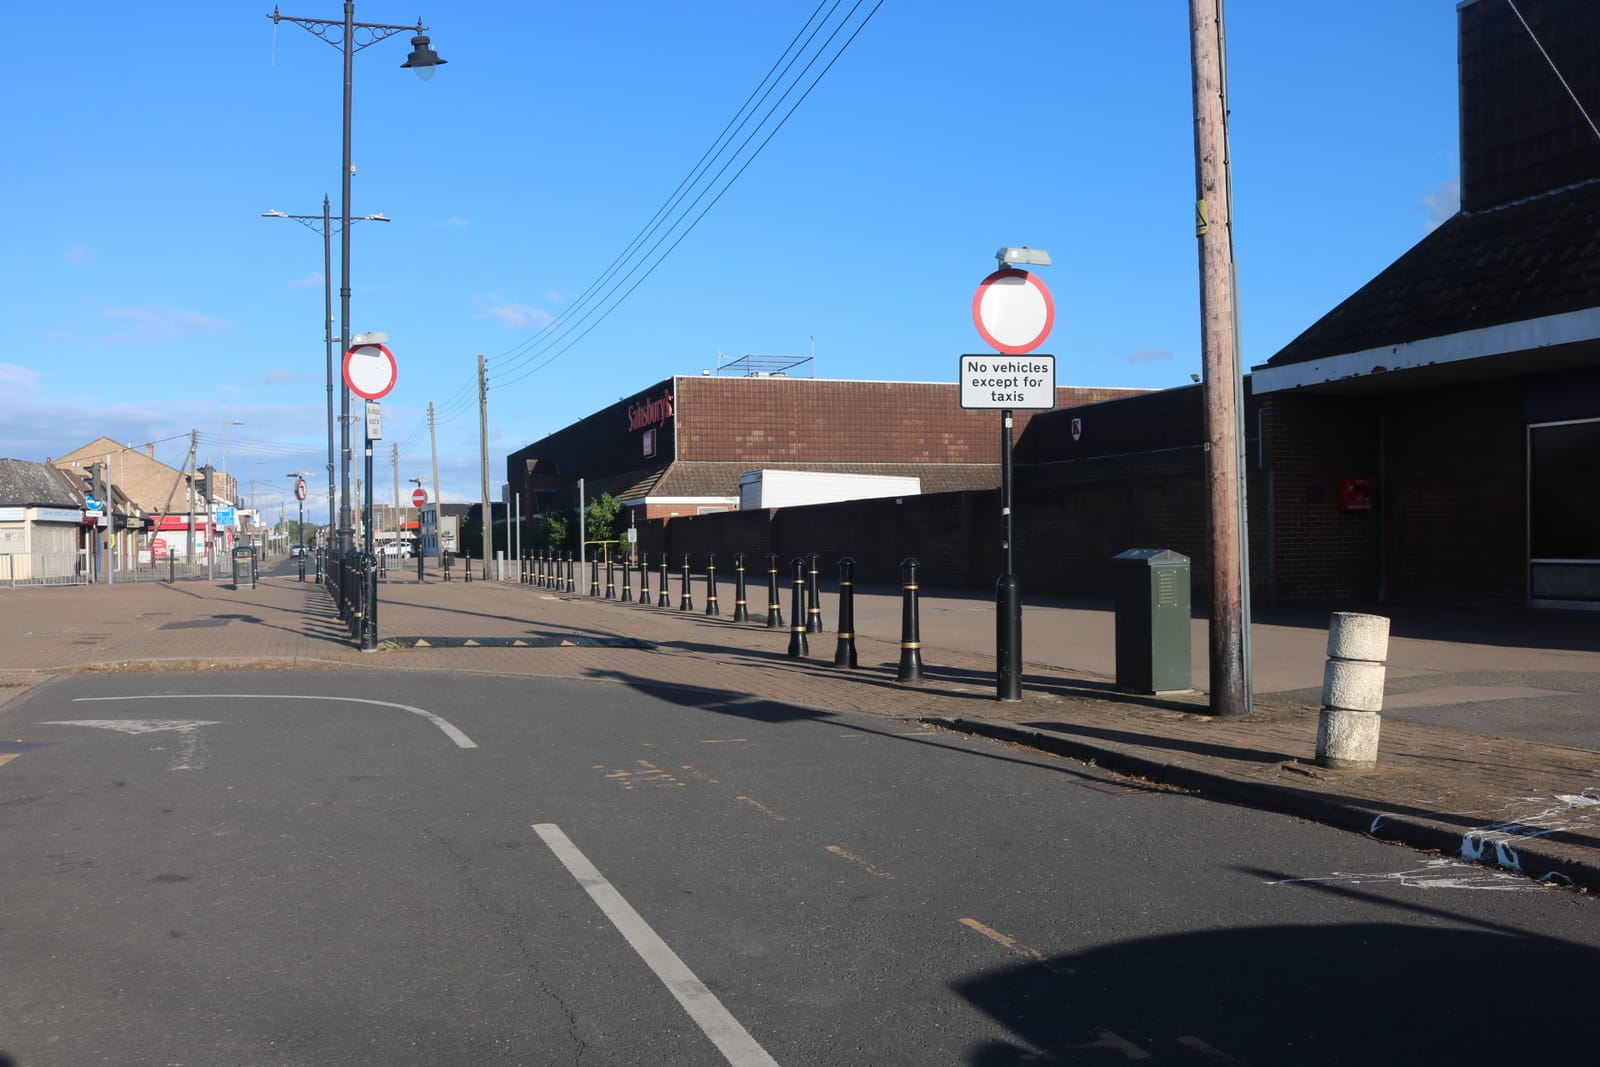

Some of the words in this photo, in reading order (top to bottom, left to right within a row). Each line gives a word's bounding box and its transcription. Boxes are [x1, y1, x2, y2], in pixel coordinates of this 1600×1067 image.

[968, 361, 987, 373] No
[992, 361, 1048, 373] vehicles
[972, 377, 1019, 389] except
[1023, 376, 1043, 388] for
[991, 390, 1024, 402] taxis
[628, 388, 673, 433] Sainsbury's
